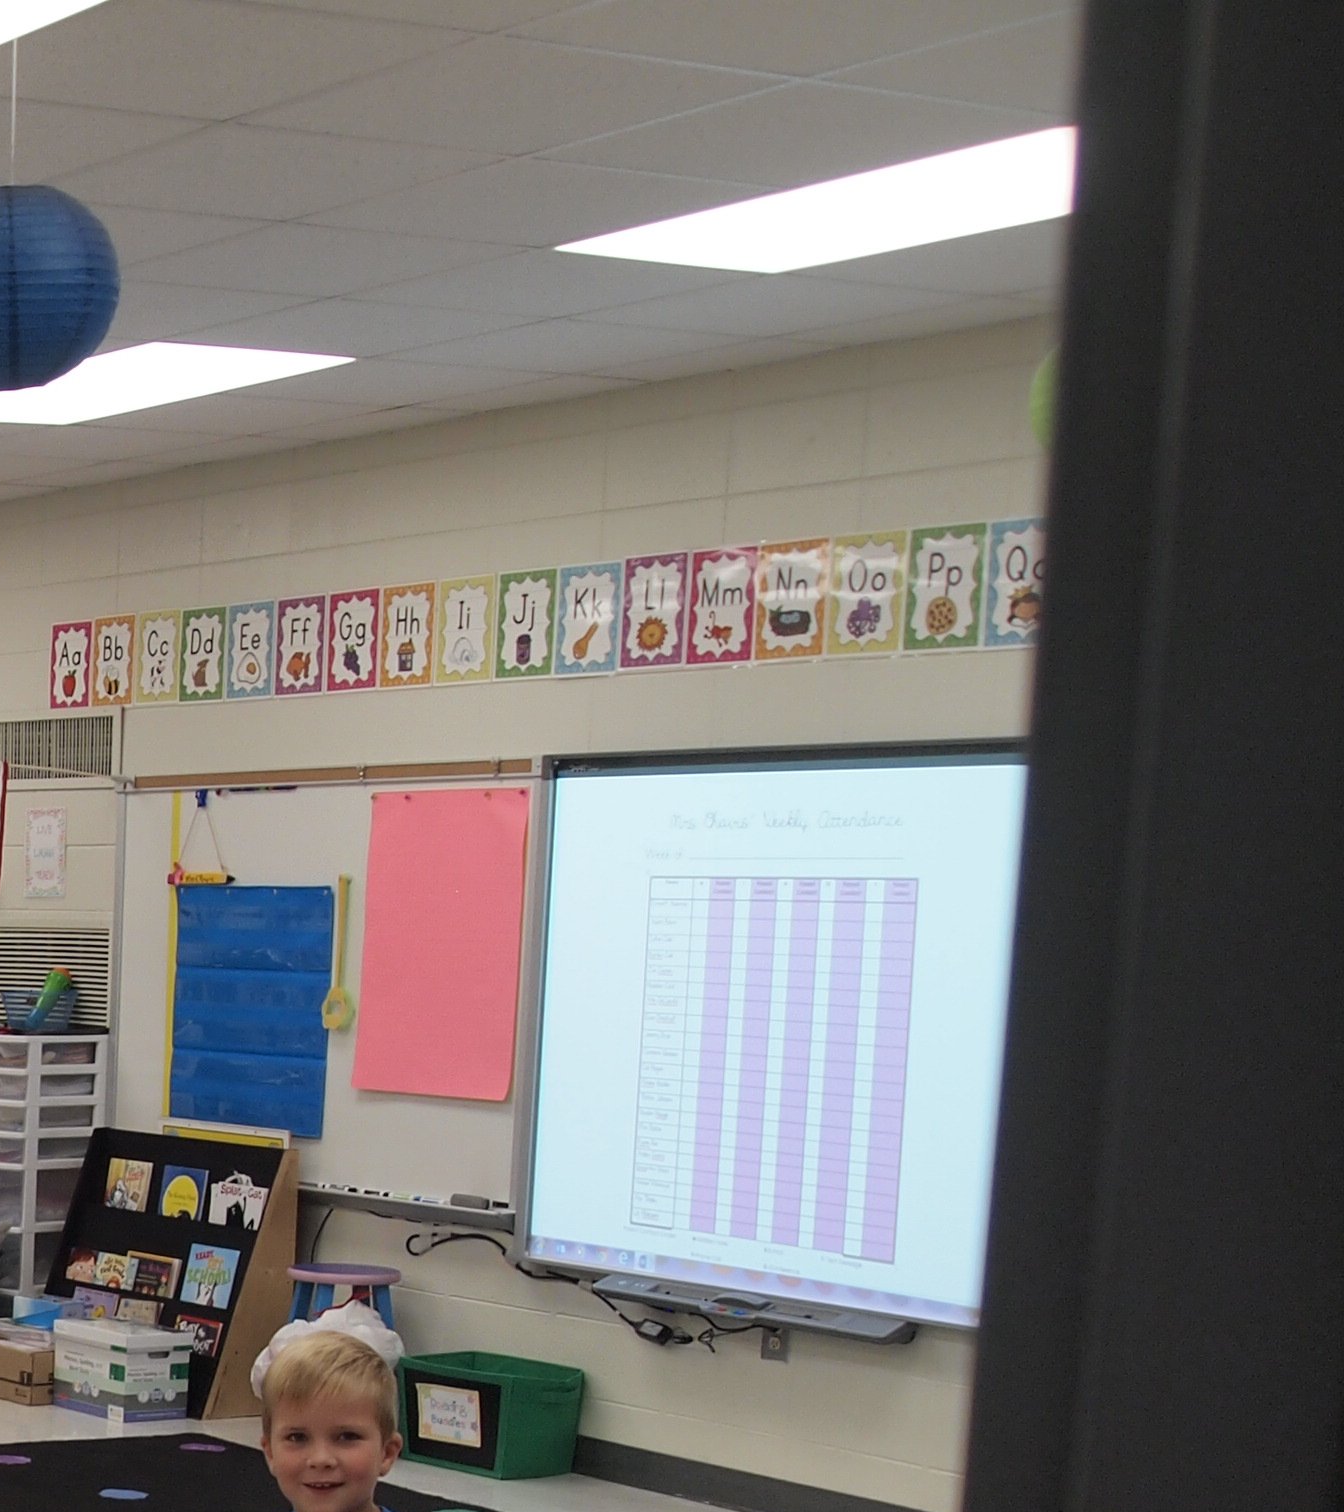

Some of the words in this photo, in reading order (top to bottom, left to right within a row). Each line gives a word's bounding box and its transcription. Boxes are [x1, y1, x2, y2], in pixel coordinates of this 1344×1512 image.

[777, 567, 808, 600] Nn
[848, 559, 887, 593] Oo
[927, 552, 963, 597] Pp
[573, 587, 602, 620] Kk
[701, 576, 743, 608] Mm
[396, 607, 420, 636] Hh
[513, 593, 536, 632] Jj
[147, 631, 169, 657] Cc
[190, 627, 213, 656] Dd
[240, 623, 261, 650] Ee
[290, 616, 312, 646] Ff
[339, 612, 366, 647] Gg
[60, 642, 82, 667] Aa
[102, 636, 124, 662] Bb
